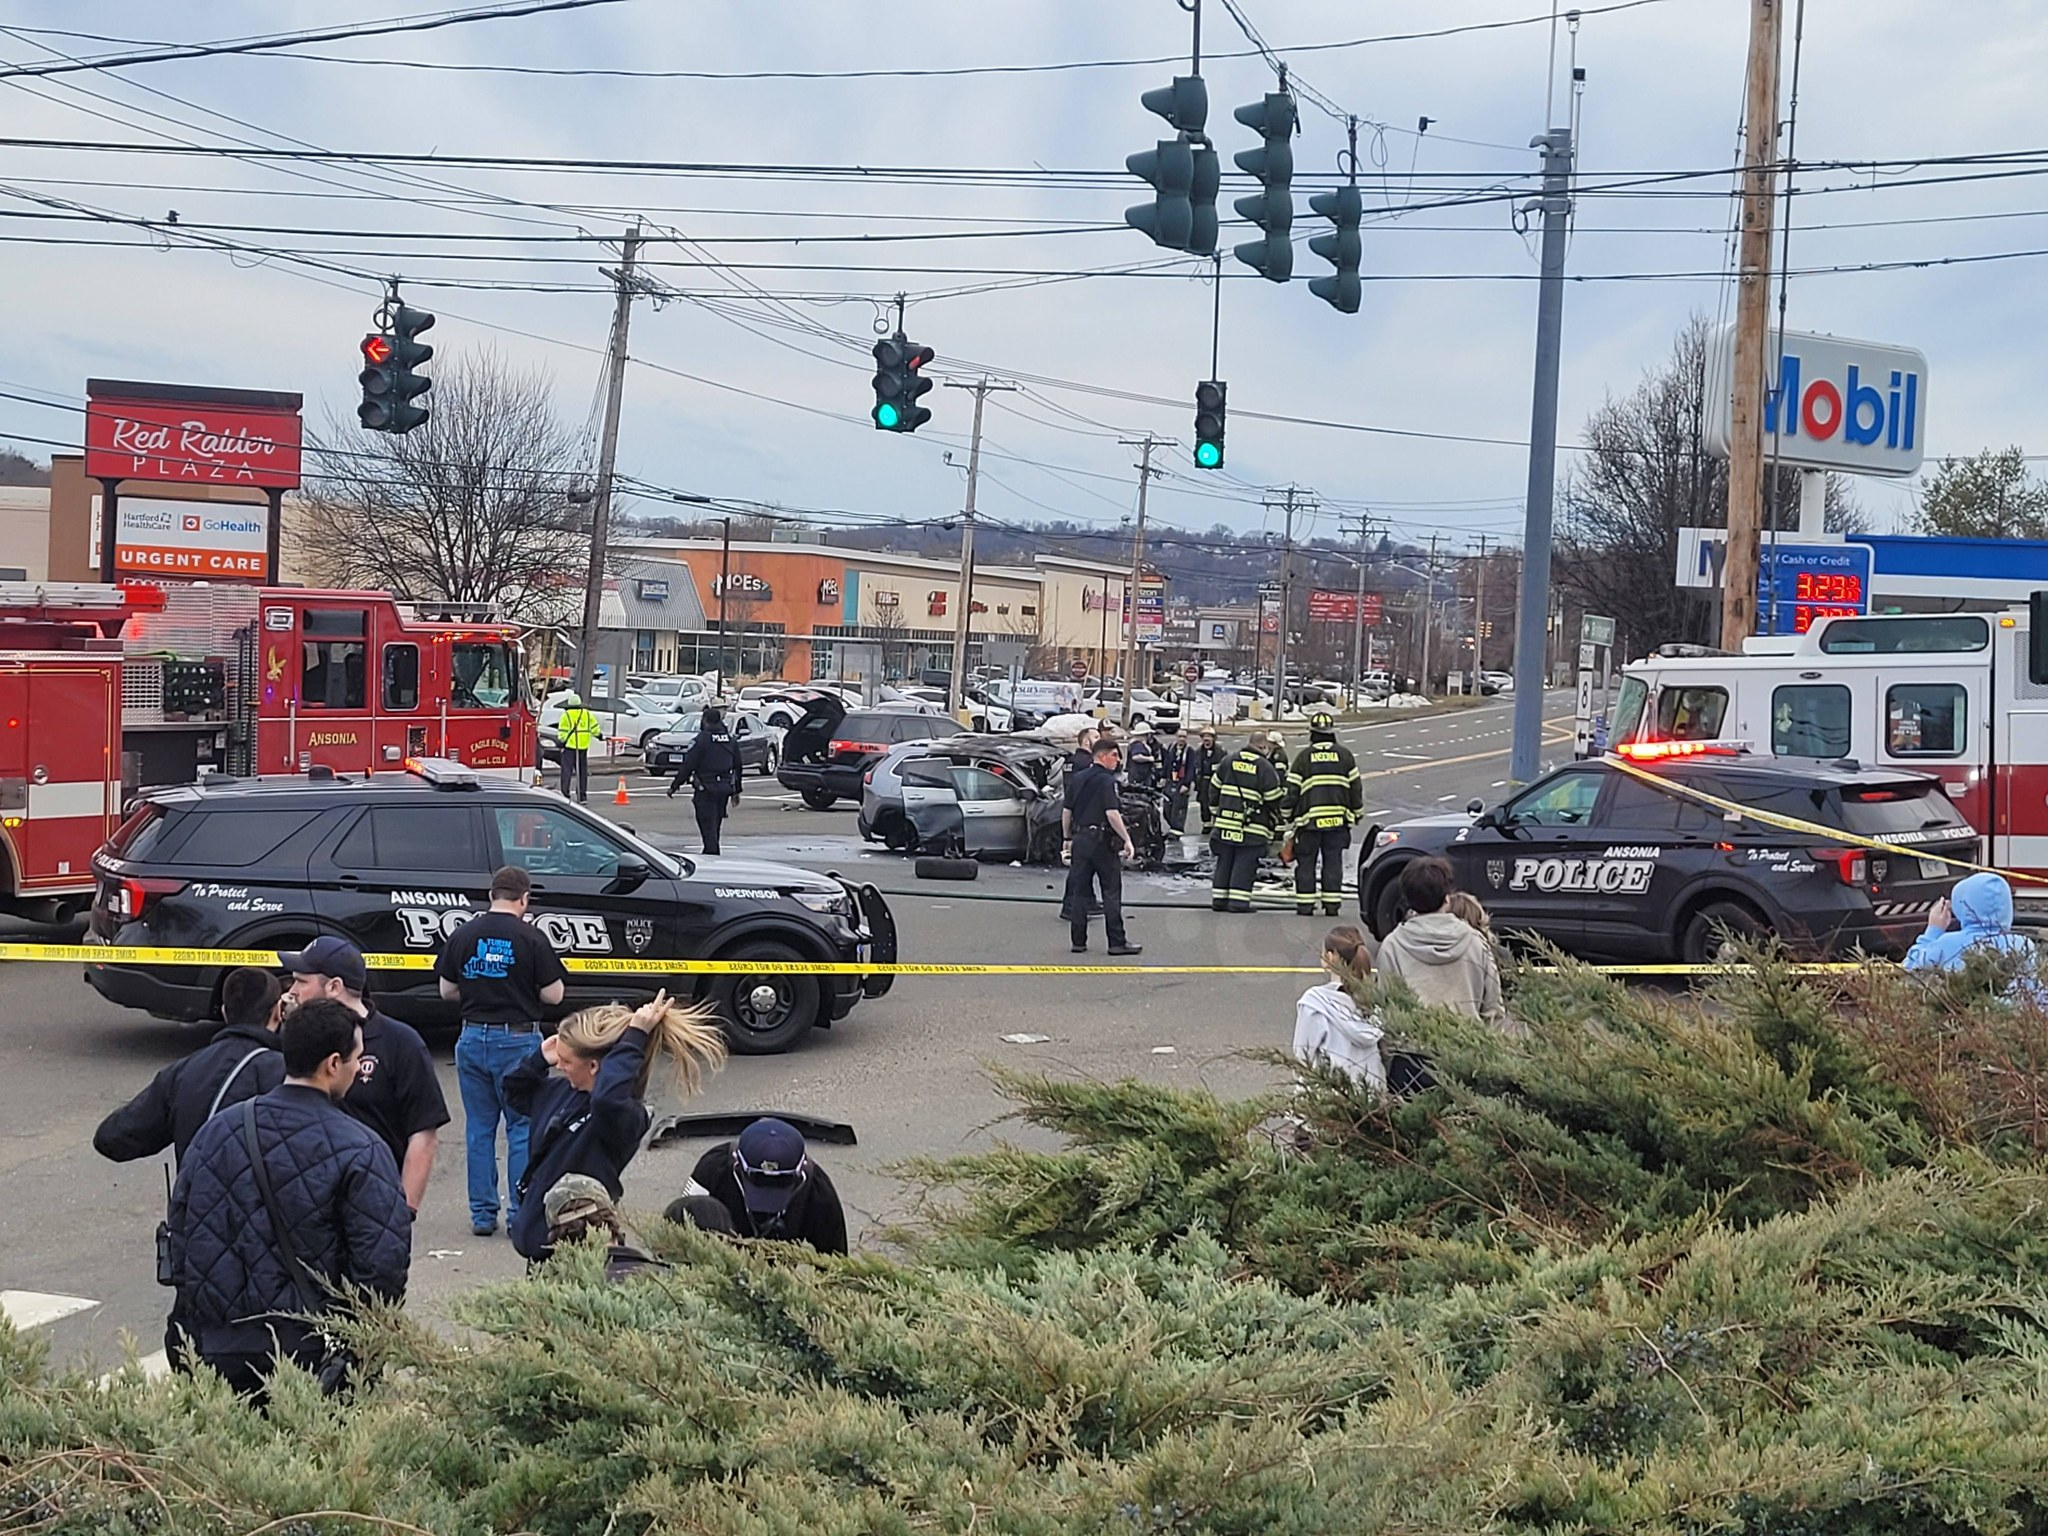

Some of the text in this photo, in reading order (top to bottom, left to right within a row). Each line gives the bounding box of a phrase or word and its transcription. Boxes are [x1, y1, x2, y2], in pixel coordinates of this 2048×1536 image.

[1764, 354, 1917, 450] Mobil
[113, 419, 276, 458] Red Raider
[133, 455, 254, 480] PLAZA
[123, 512, 160, 522] Hartford
[123, 520, 171, 531] HealthCare
[203, 518, 261, 533] GoHealth
[121, 550, 261, 570] URGENT CARE
[1781, 553, 1805, 565] Cash
[1807, 557, 1818, 565] or
[1819, 555, 1850, 566] Credit
[1582, 681, 1588, 708] 8
[308, 731, 357, 746] ANSONIA
[1455, 828, 1469, 841] 2
[1872, 832, 1928, 845] ANSONIA
[1603, 846, 1660, 858] ANSONIA
[1747, 849, 1789, 861] To Protect
[1771, 860, 1815, 873] and Serve
[1509, 858, 1655, 894] POLICE
[192, 884, 248, 898] To Protect
[714, 888, 781, 900] SUPERVISOR
[227, 898, 284, 912] and Serve
[390, 890, 471, 907] ANSONIA
[395, 907, 613, 953] POCE
[626, 919, 654, 928] POLICE
